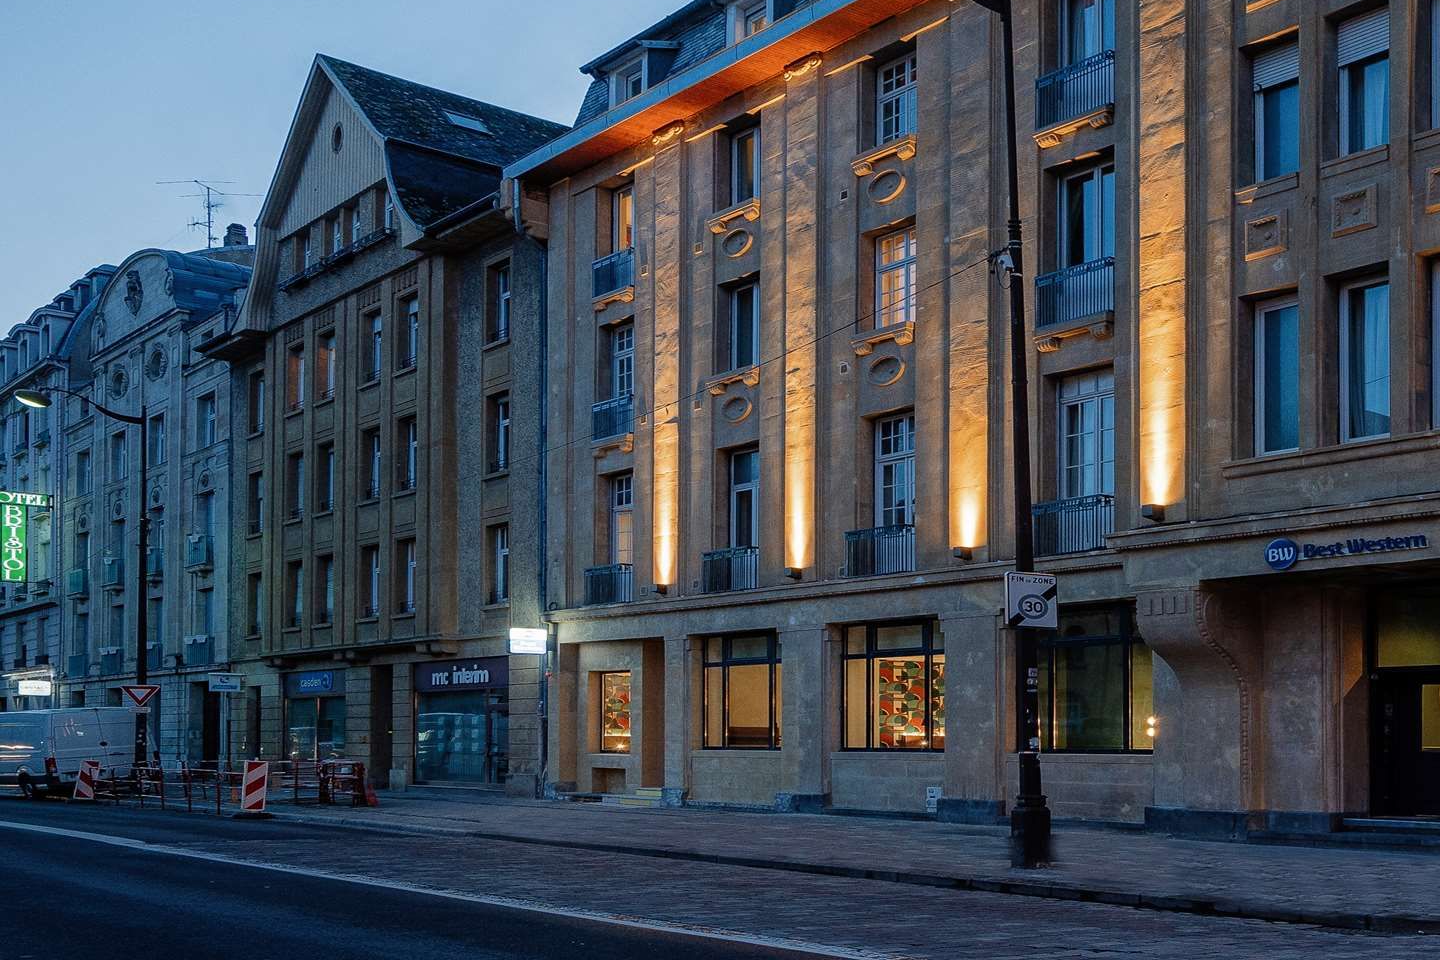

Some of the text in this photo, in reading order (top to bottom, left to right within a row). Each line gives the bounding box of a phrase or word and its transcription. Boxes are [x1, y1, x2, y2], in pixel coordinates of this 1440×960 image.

[4, 505, 24, 581] BRISTOL
[1303, 533, 1429, 558] Best Western
[1268, 546, 1294, 562] BW
[1011, 575, 1025, 583] FIN
[1032, 577, 1054, 585] ZONE
[1024, 601, 1044, 613] 30
[432, 664, 490, 686] mc interim
